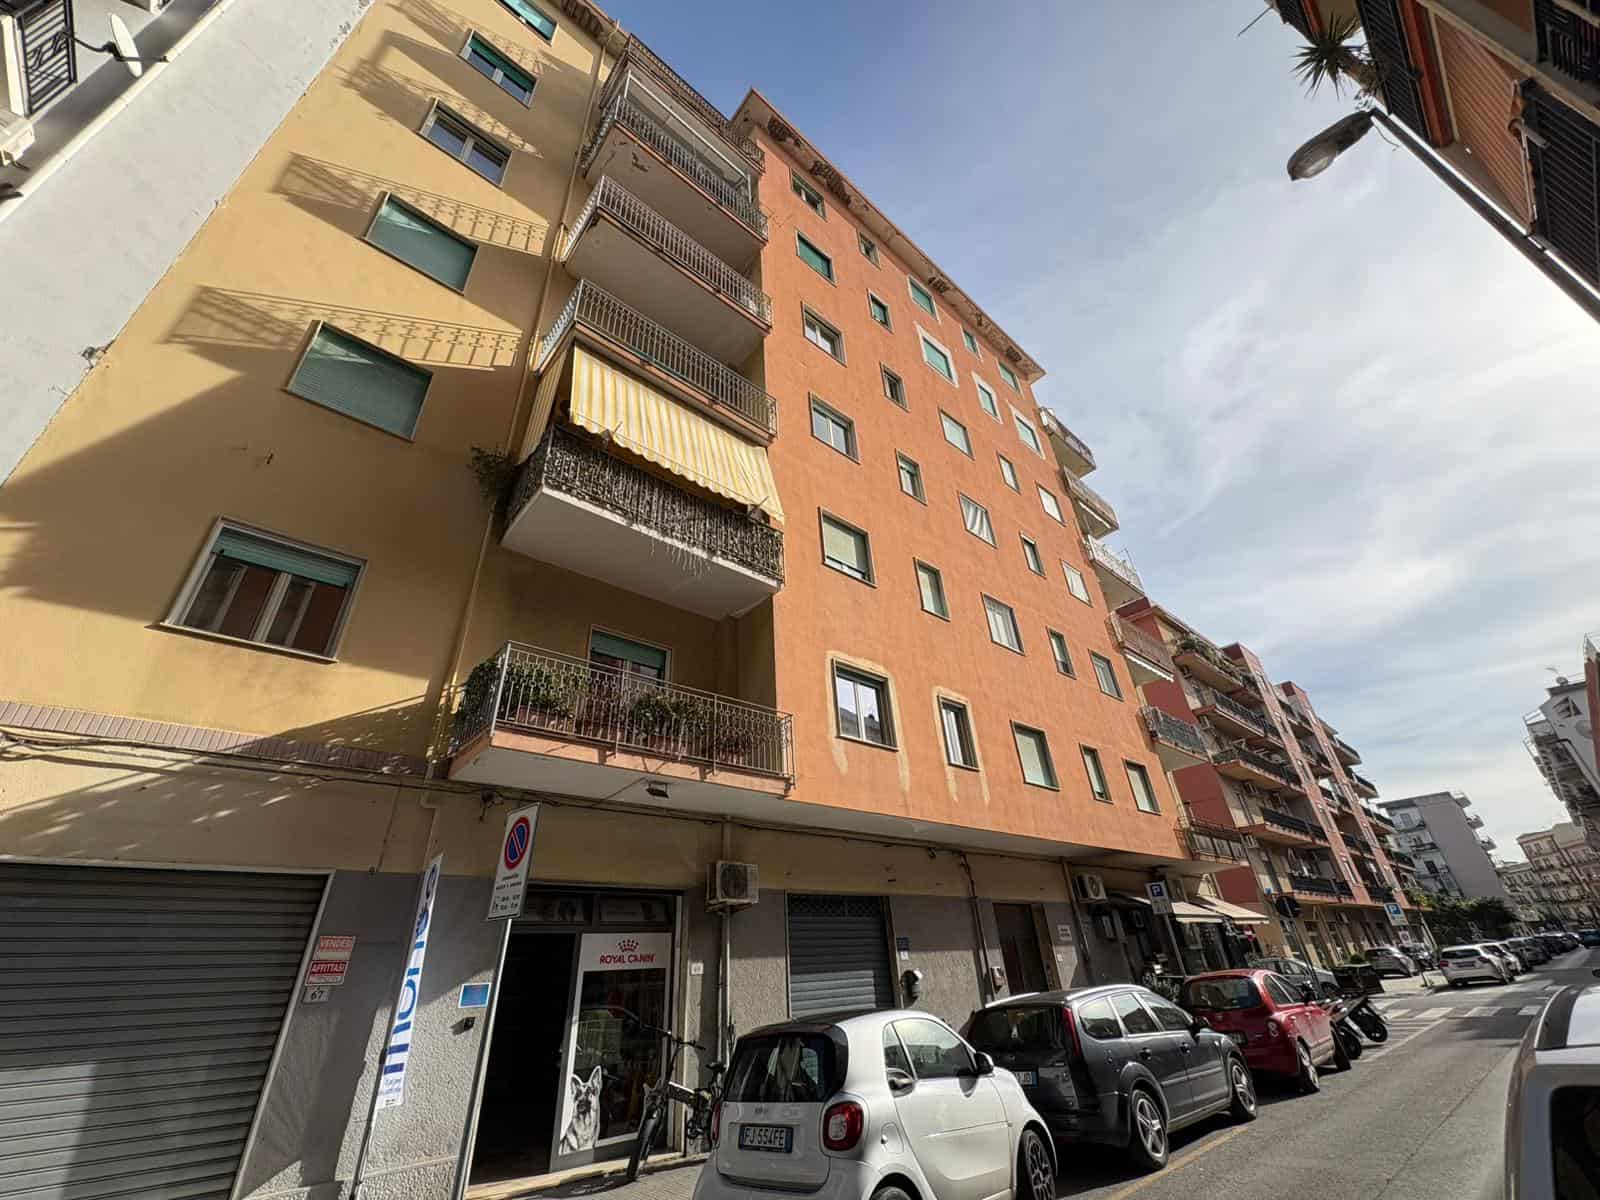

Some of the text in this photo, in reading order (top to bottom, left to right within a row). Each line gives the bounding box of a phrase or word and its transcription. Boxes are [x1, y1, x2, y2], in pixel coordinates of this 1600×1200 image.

[1389, 904, 1398, 914] P
[600, 953, 656, 964] ROYAL CANIN
[311, 990, 323, 1000] 67
